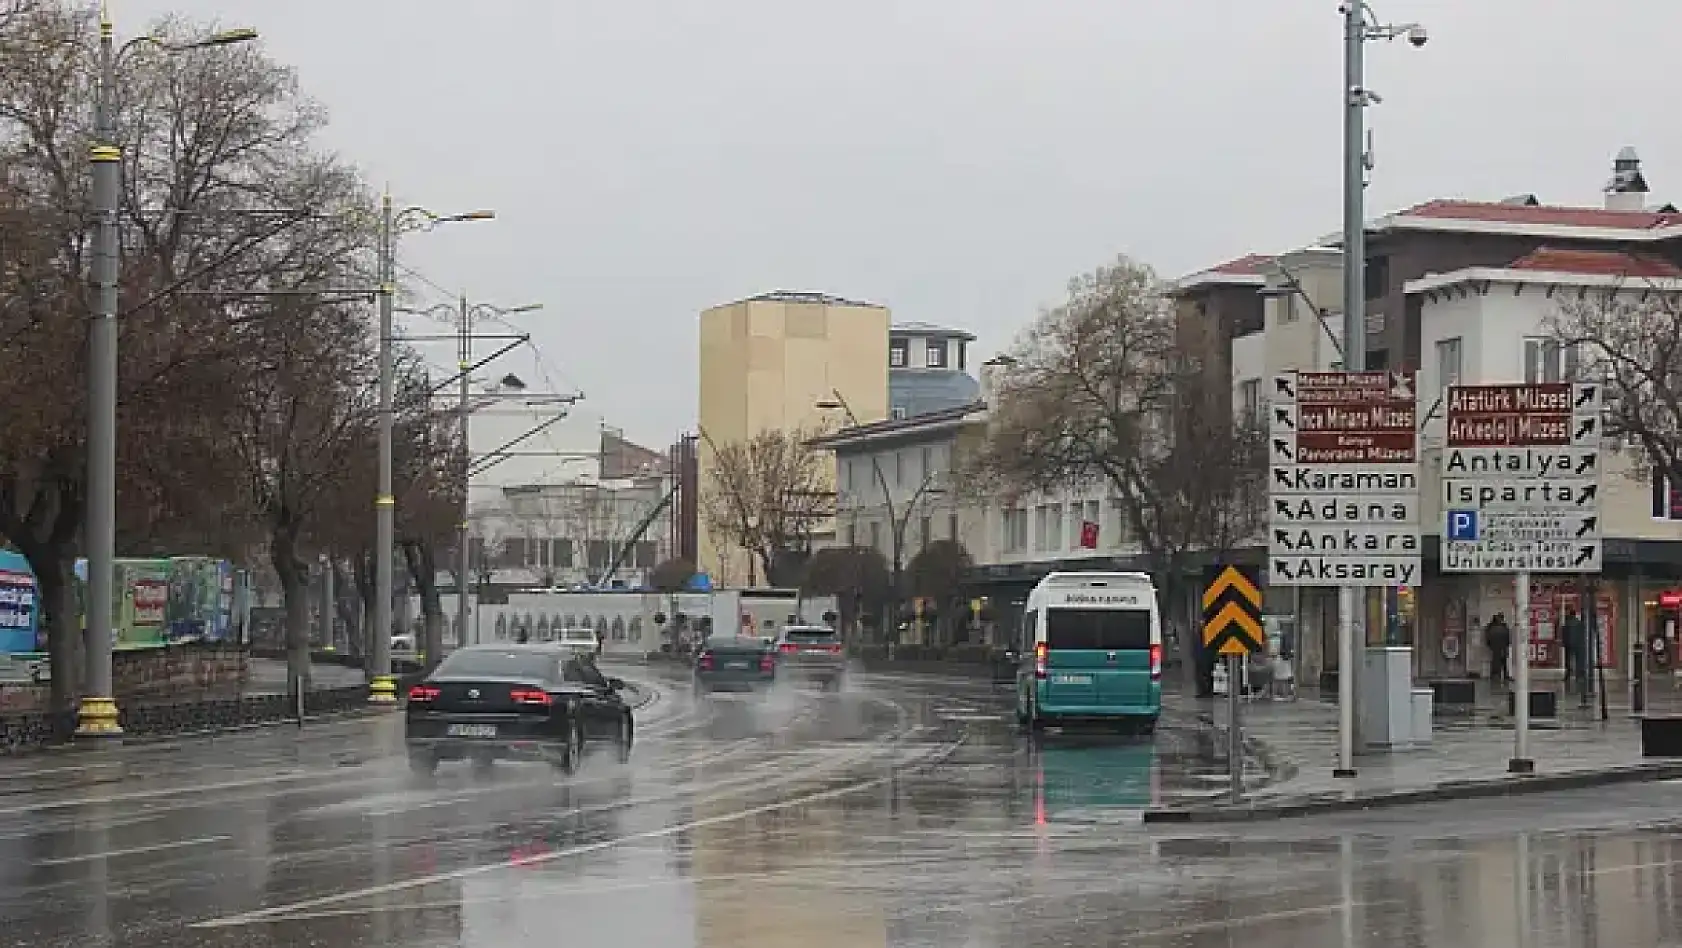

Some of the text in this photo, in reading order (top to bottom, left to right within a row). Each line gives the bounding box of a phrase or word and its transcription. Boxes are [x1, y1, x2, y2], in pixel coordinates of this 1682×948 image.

[1450, 386, 1571, 411] Atatürk Müzesi
[1447, 449, 1571, 477] Antalya
[1296, 468, 1416, 489] Karaman
[1446, 481, 1572, 508] Isparta
[1296, 498, 1407, 520] Adana
[1454, 512, 1470, 536] P
[1296, 528, 1417, 550] Ankara
[1296, 558, 1415, 583] Aksaray
